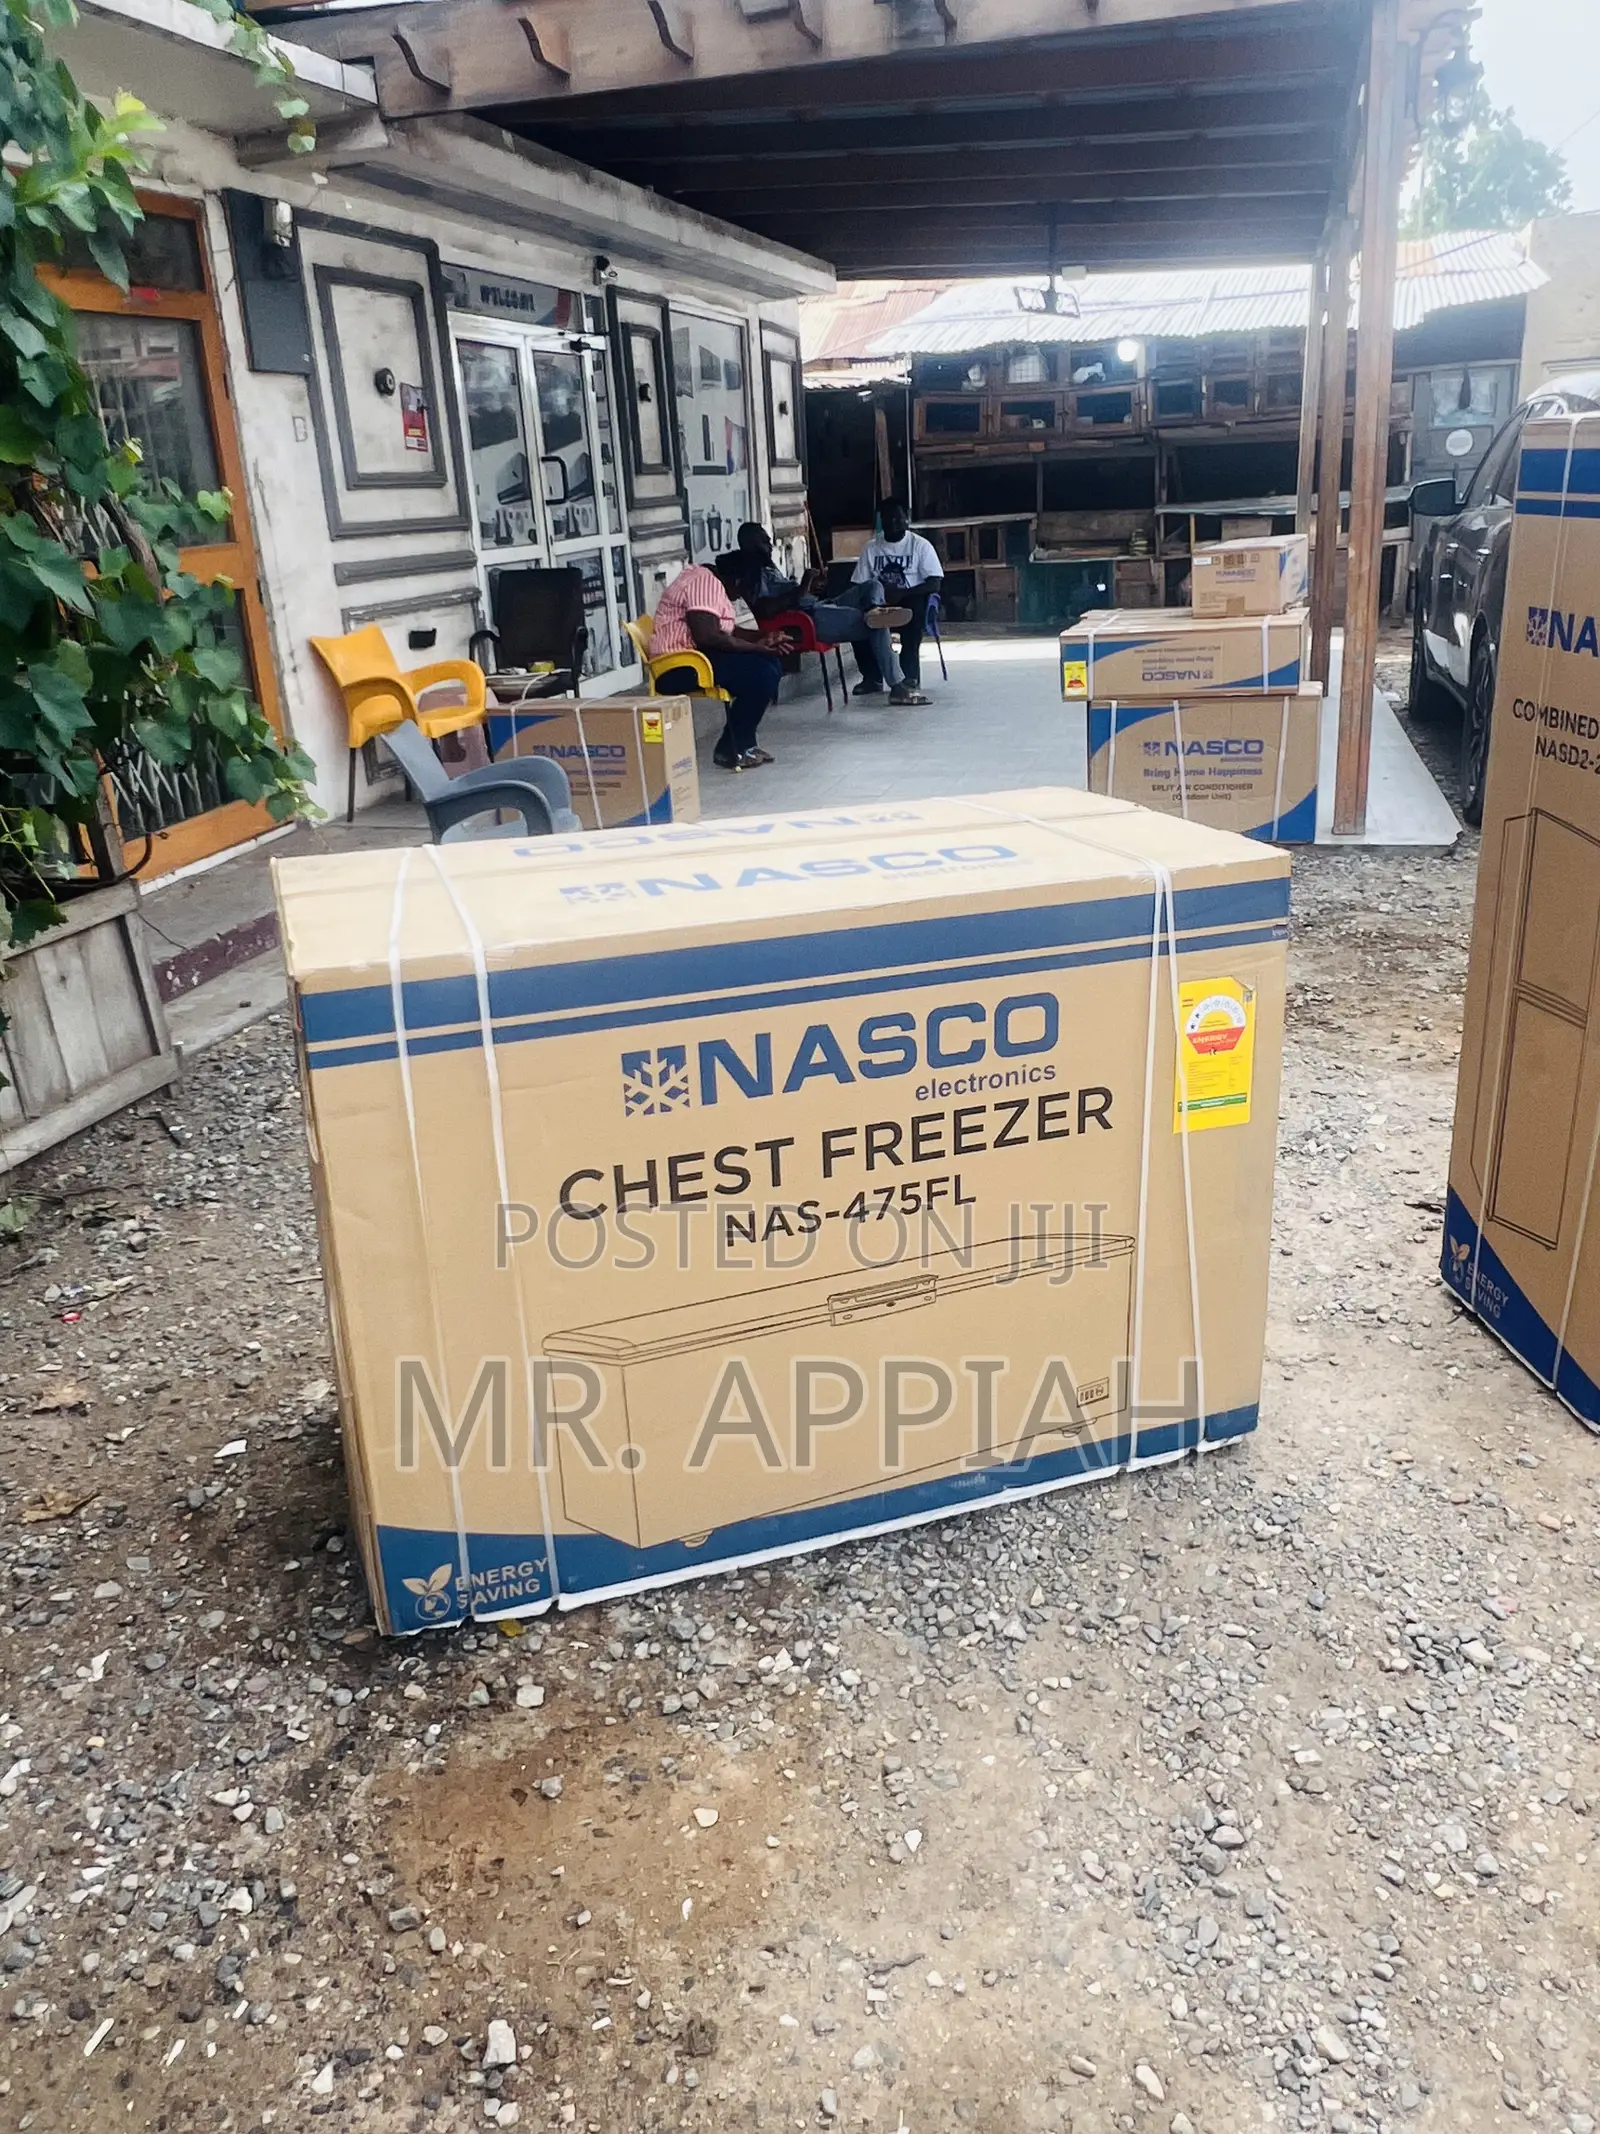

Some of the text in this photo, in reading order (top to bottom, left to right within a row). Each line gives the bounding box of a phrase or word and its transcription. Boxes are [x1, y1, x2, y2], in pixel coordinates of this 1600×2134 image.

[1142, 670, 1200, 681] NASCO
[1511, 697, 1600, 740] COMBINED
[1164, 739, 1264, 756] NASCO
[1208, 766, 1263, 778] Happiness
[637, 845, 1019, 898] NASCO
[698, 990, 1060, 1106] NASCO
[915, 1061, 1057, 1102] electronics
[559, 1086, 1114, 1220] CHEST FREEZER
[725, 1173, 977, 1247] NAS-475FL
[455, 1557, 549, 1592] ENERGY
[456, 1578, 541, 1610] SAVING
